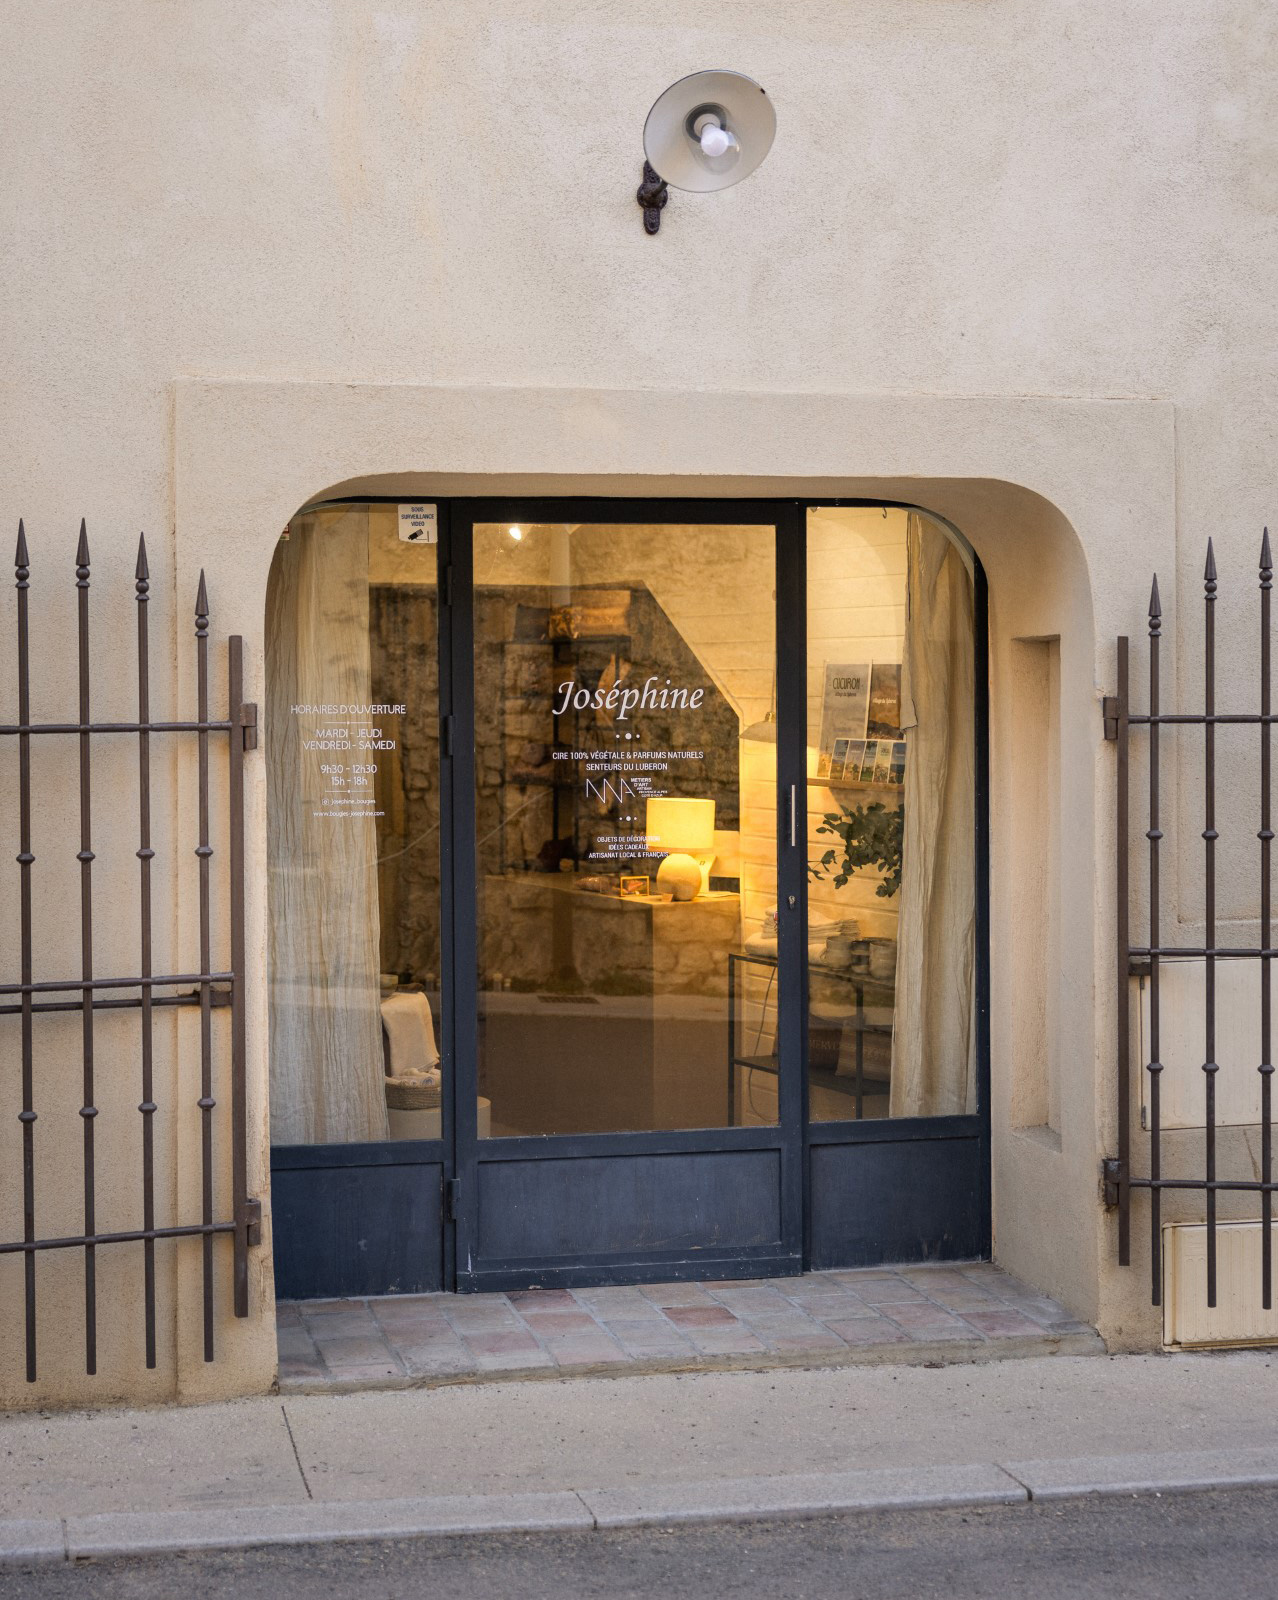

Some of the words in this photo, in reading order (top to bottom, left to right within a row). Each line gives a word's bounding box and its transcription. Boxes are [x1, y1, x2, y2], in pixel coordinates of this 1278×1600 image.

[552, 676, 704, 720] Joséphine
[290, 705, 338, 714] HORAIRES
[340, 705, 406, 714] D'OUVERTURE
[316, 729, 348, 738] MARDI
[357, 729, 382, 738] JEUDI
[303, 741, 351, 750] VENDREDI
[358, 741, 396, 750] SAMEDI
[552, 752, 569, 760] CIRE
[570, 752, 589, 760] 100%
[590, 750, 625, 760] VÉGÉTALE
[633, 751, 667, 759] PARFUMS
[668, 751, 704, 759] NATURELS
[320, 764, 344, 774] 9h30
[352, 764, 378, 774] 12h30
[586, 763, 623, 771] SENTEURS
[624, 763, 634, 771] DU
[635, 763, 668, 771] LUBERON
[331, 776, 345, 786] 15h
[353, 776, 368, 786] 18h
